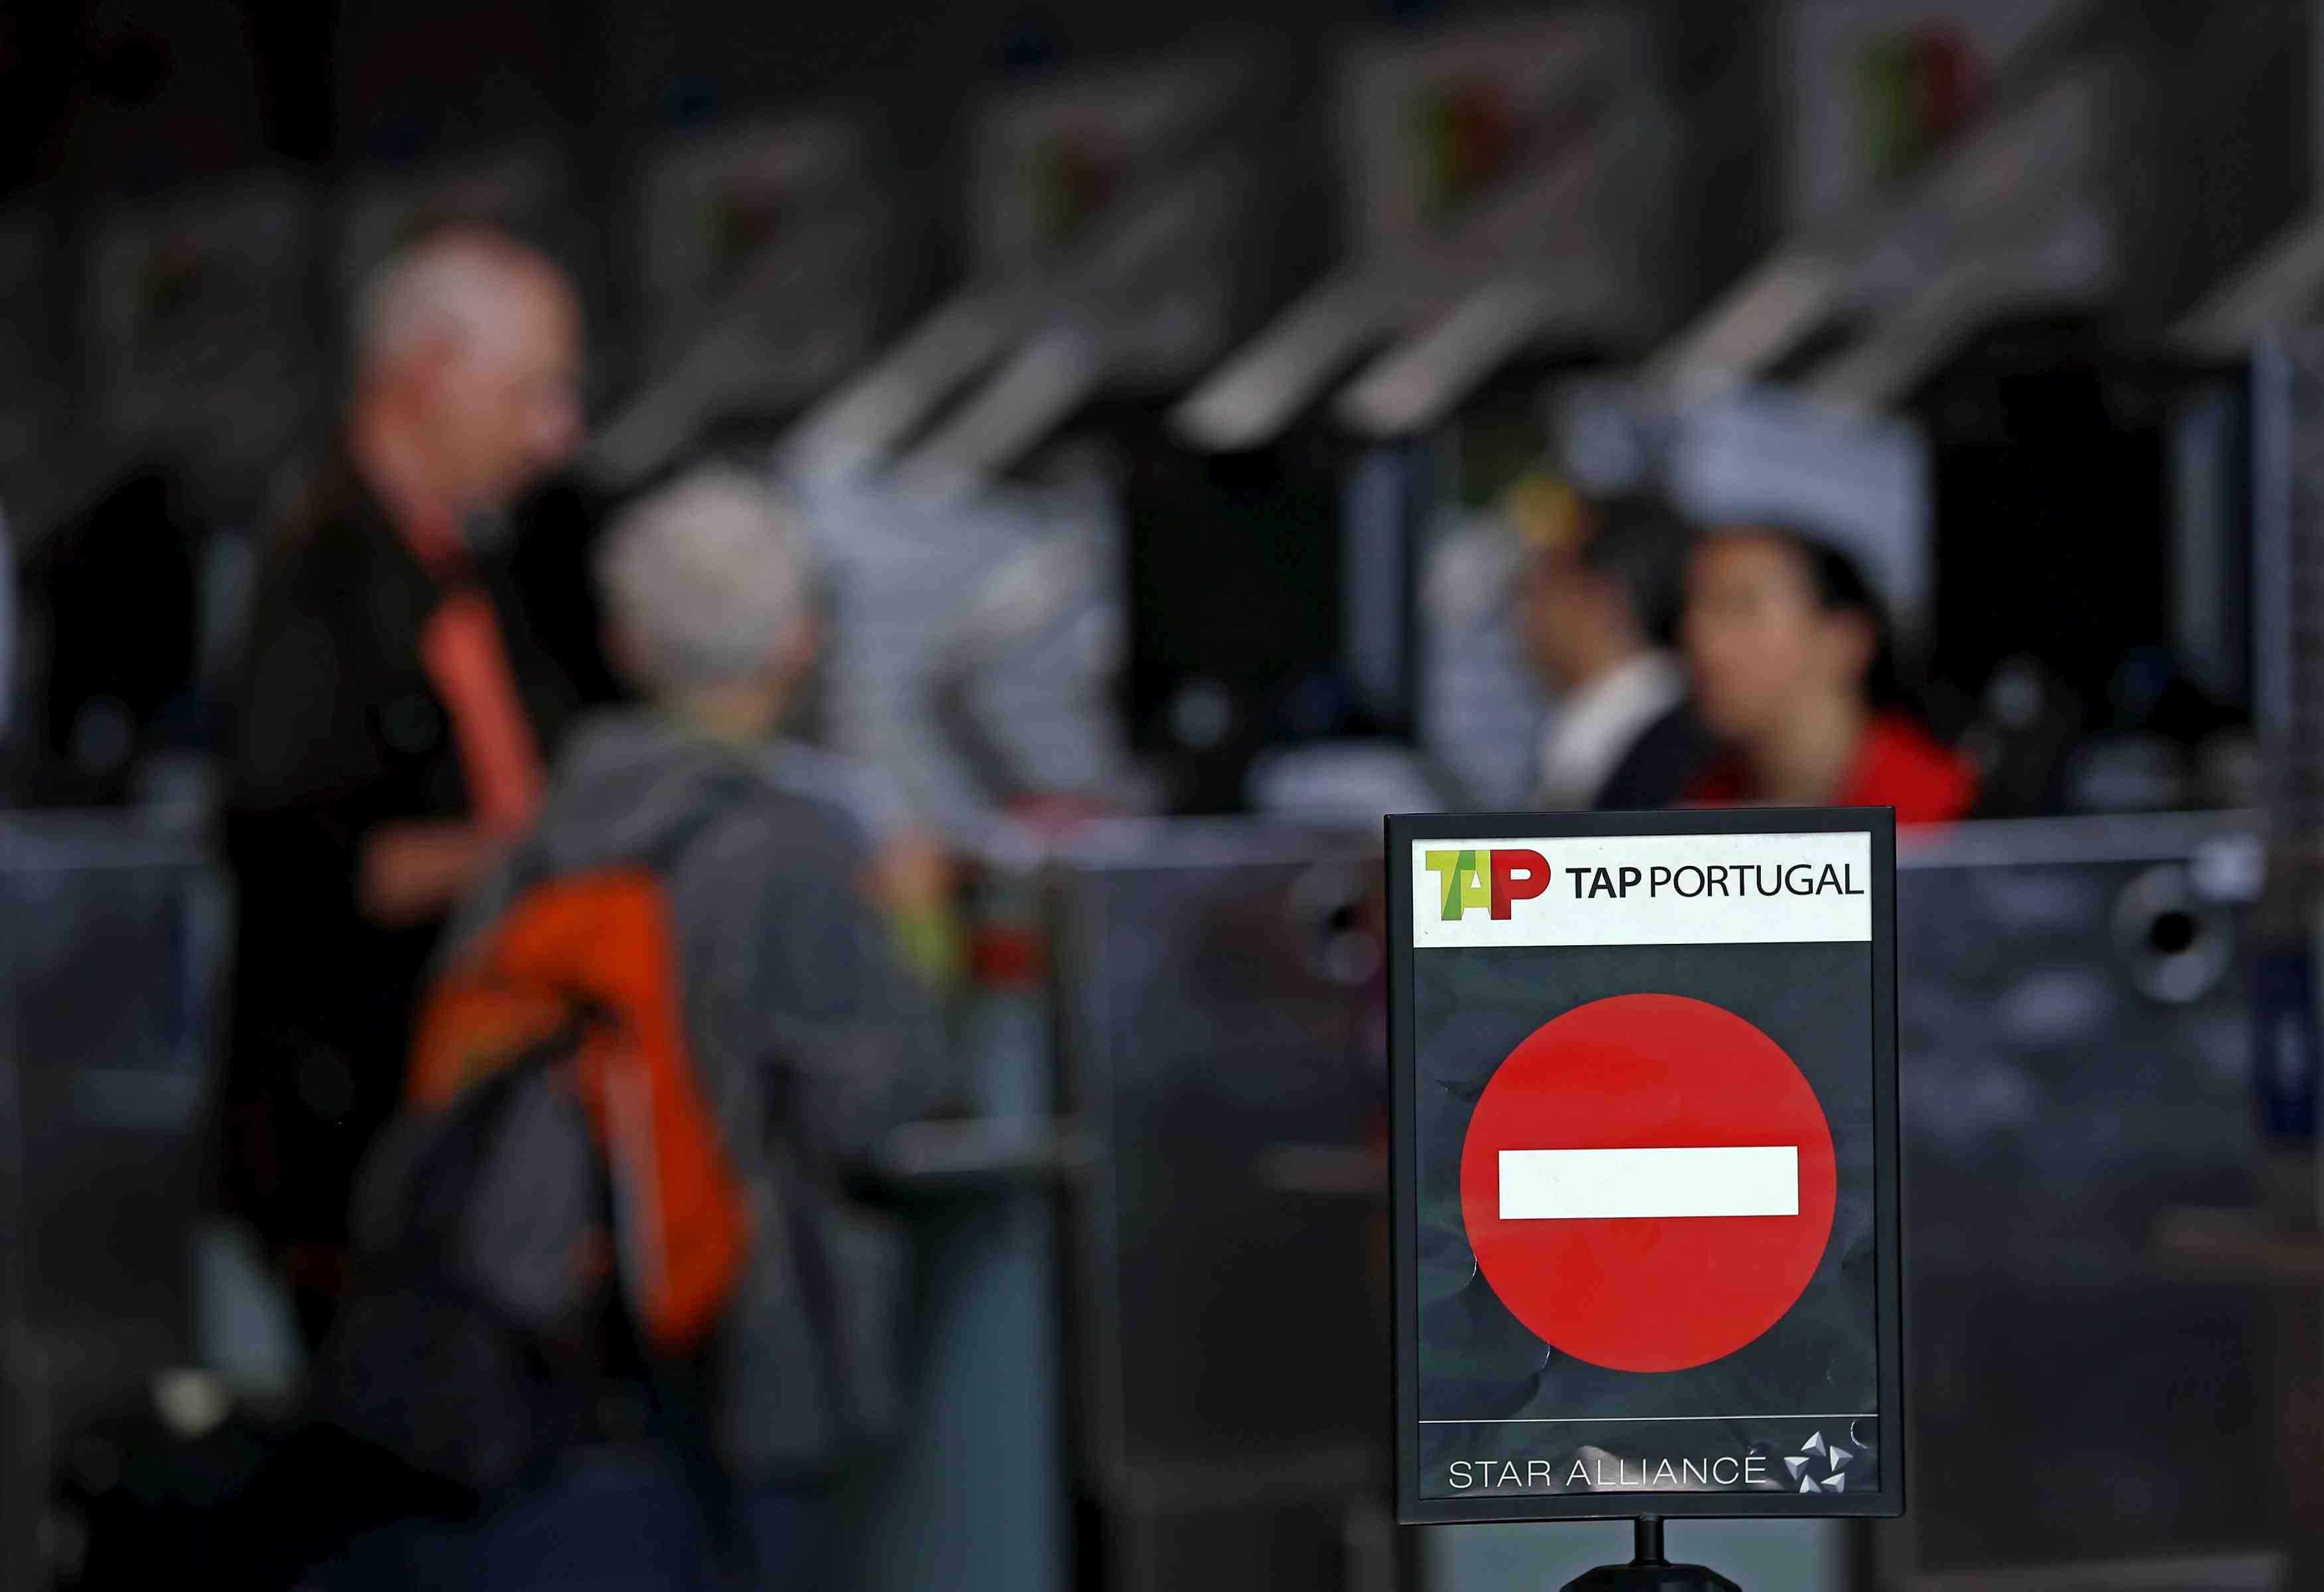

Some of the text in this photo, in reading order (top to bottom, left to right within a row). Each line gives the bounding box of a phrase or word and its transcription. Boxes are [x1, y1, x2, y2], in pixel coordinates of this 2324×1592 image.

[1425, 849, 1551, 921] TAP
[1566, 863, 1865, 899] TAP PORTUGAL
[1449, 1456, 1767, 1488] STAR ALLIANCE
